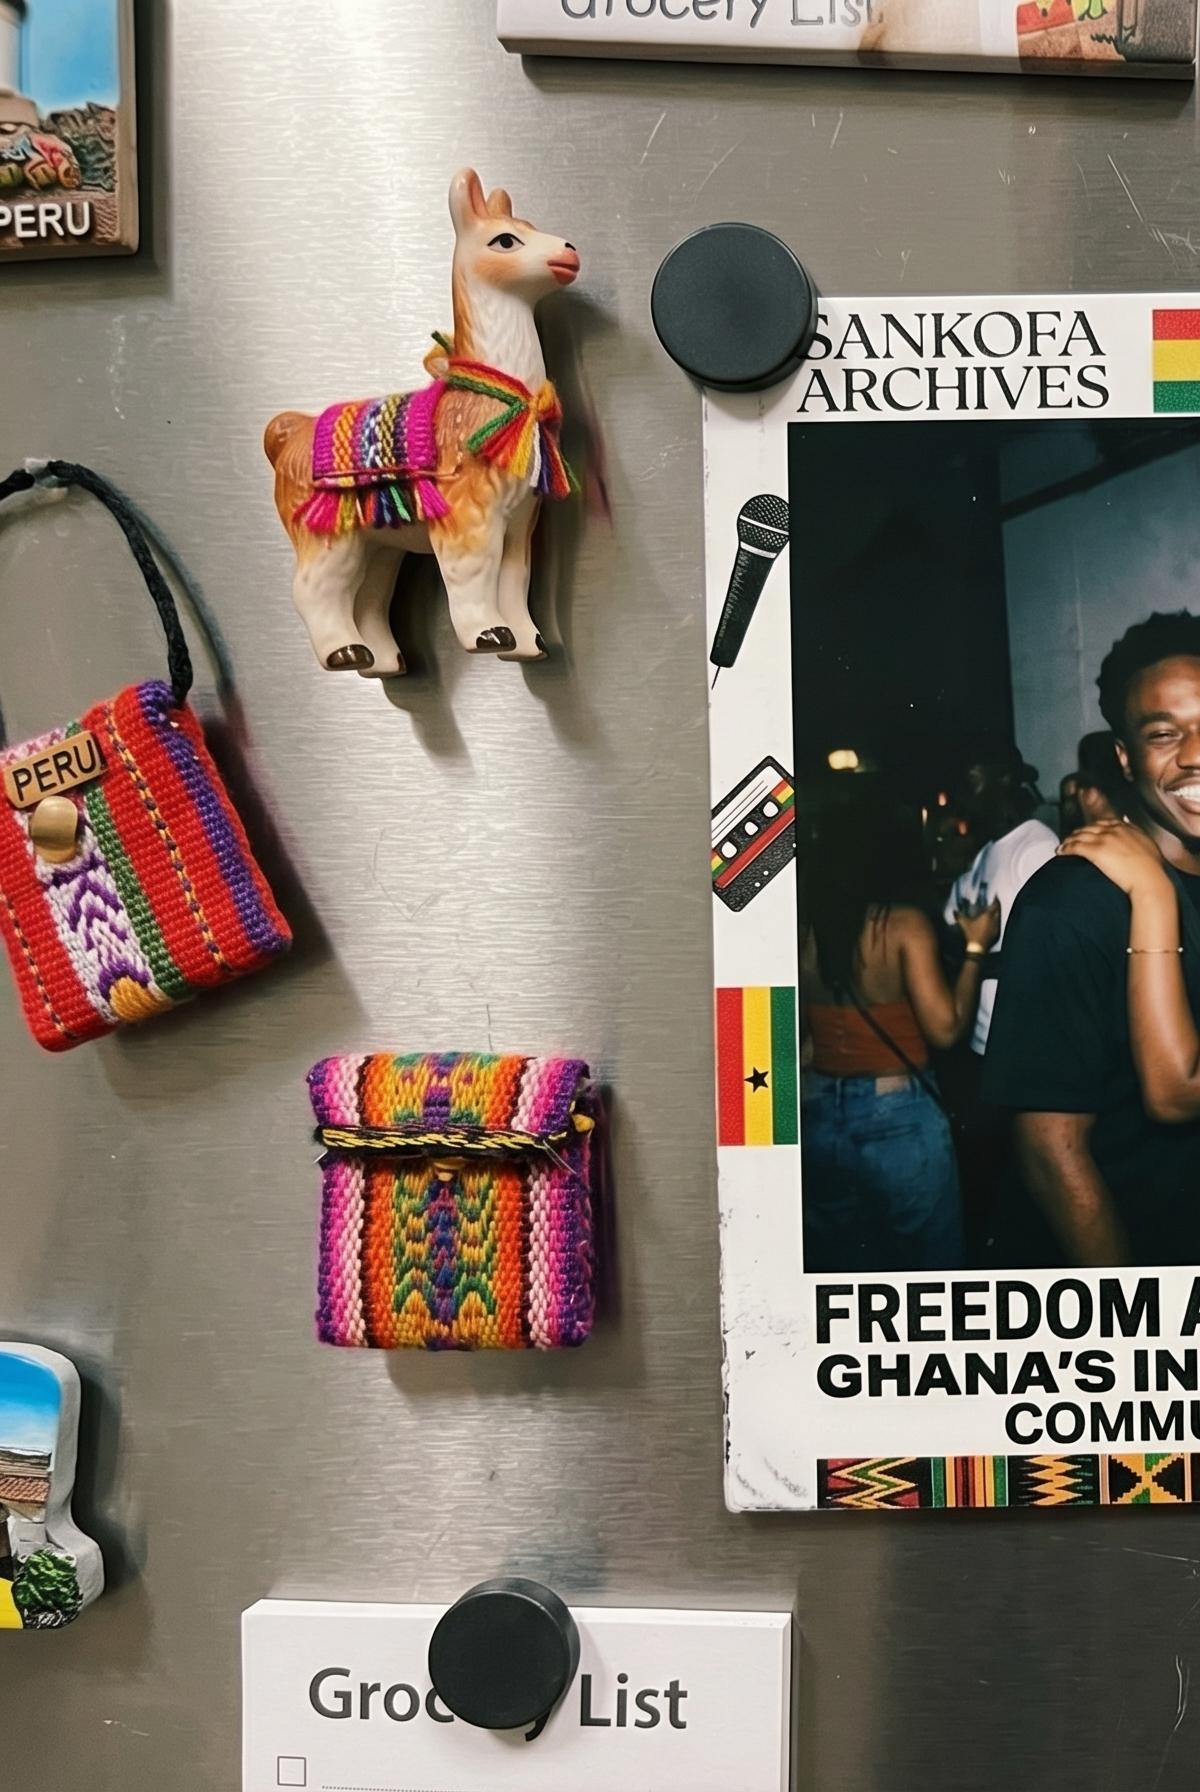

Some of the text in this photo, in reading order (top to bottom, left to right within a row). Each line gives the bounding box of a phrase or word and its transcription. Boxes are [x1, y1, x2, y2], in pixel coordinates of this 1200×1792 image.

[806, 310, 1107, 360] SANKOFA
[796, 365, 1110, 413] ARCHIVES
[12, 740, 97, 802] PERU
[815, 1277, 1161, 1344] FREEDOM
[816, 1349, 1116, 1398] GHANA'S
[308, 1667, 688, 1742] Groc List
